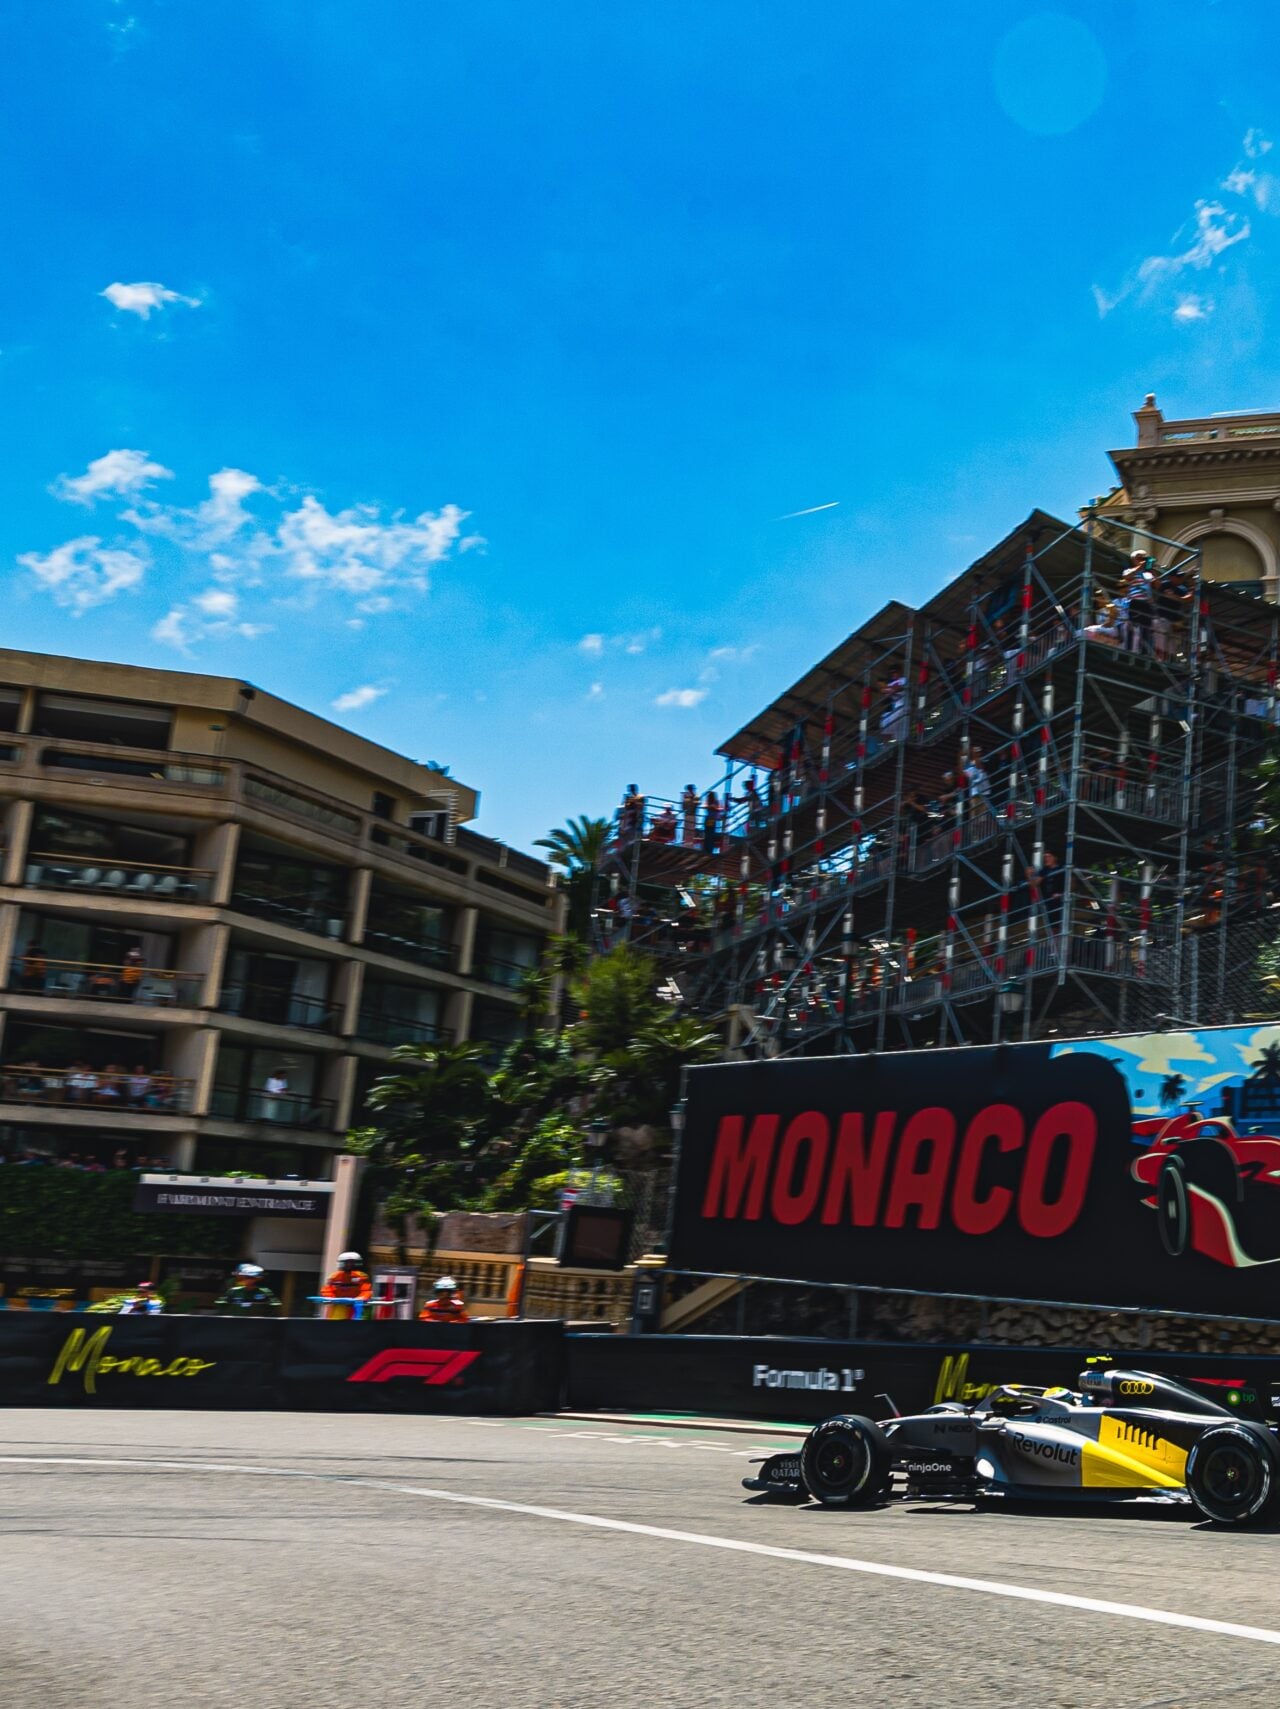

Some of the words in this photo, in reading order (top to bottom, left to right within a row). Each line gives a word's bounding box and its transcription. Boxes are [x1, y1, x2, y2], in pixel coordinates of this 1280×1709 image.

[702, 1101, 1096, 1237] MONACO
[48, 1326, 216, 1393] Monaco
[753, 1364, 840, 1391] Formula
[1043, 1416, 1072, 1425] Castrol
[1012, 1432, 1079, 1466] Revolut
[771, 1468, 800, 1479] QATAR
[908, 1462, 952, 1473] ninjaOne
